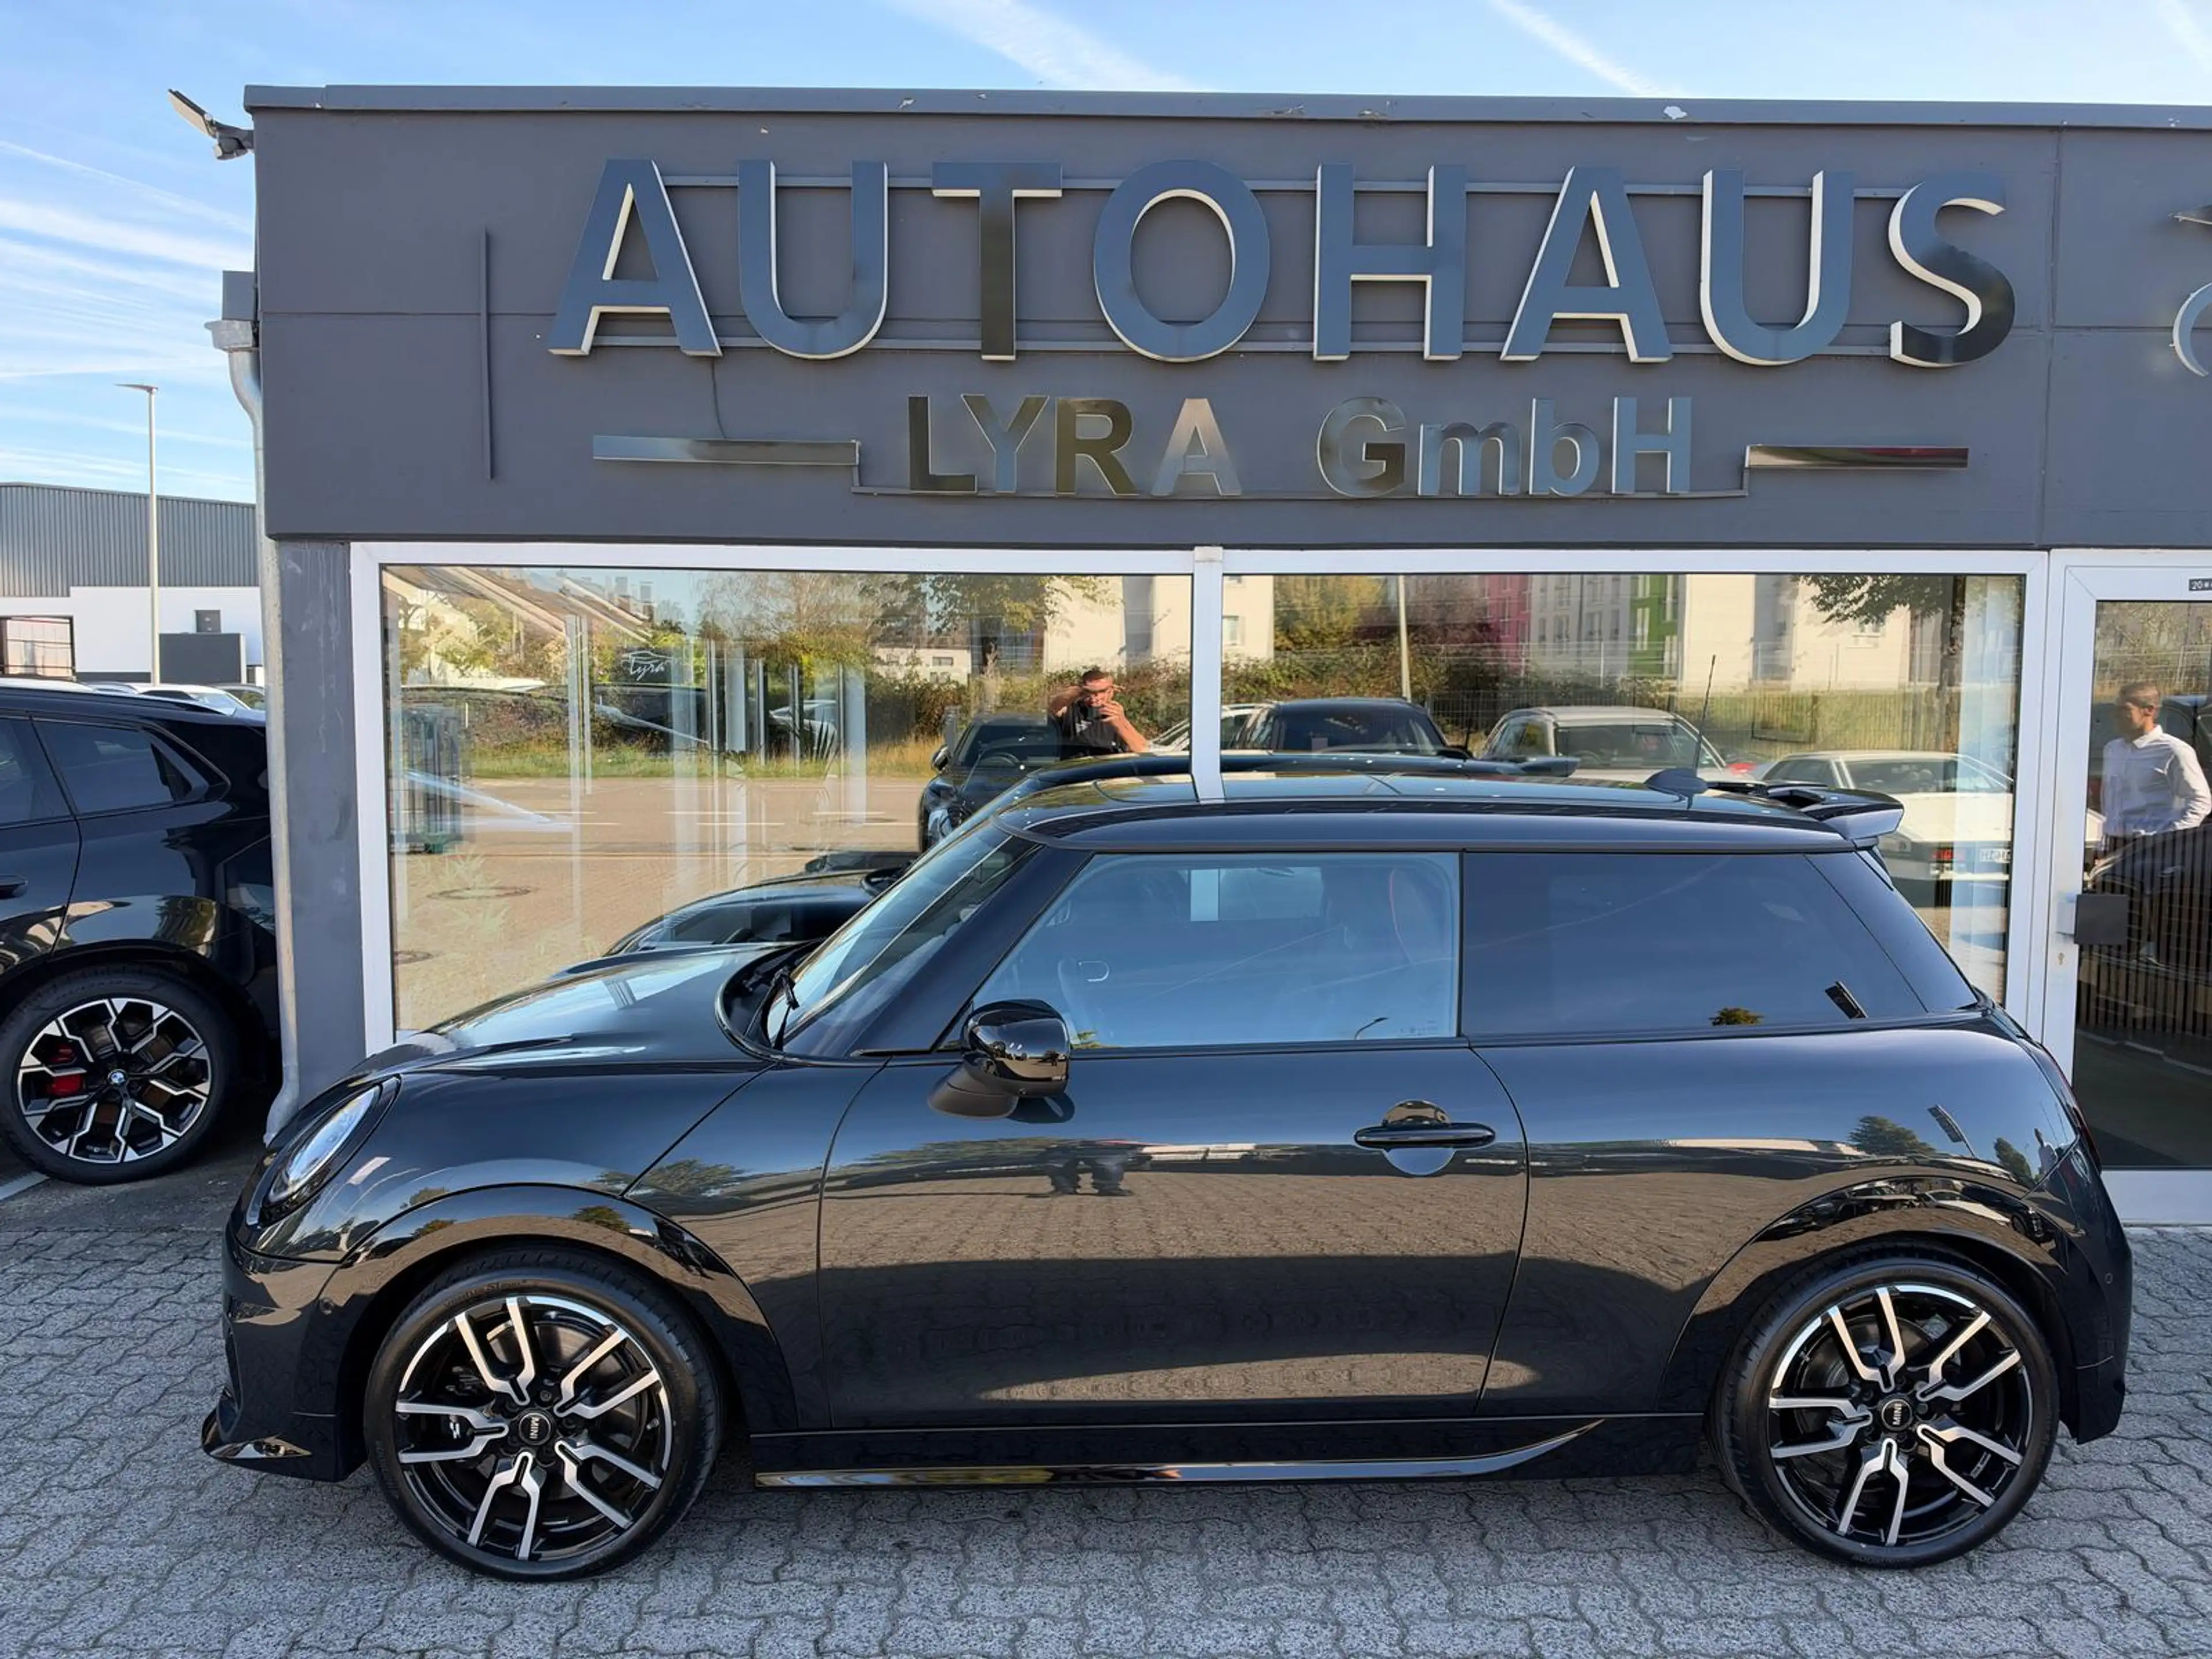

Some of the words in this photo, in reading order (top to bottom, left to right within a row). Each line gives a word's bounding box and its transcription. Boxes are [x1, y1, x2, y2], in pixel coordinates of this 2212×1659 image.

[548, 158, 2015, 368] AUTOHAUS
[908, 394, 1242, 496] LYRA
[1317, 396, 1692, 497] GmbH
[530, 1416, 540, 1439] MINI
[1893, 1403, 1902, 1425] MINI
